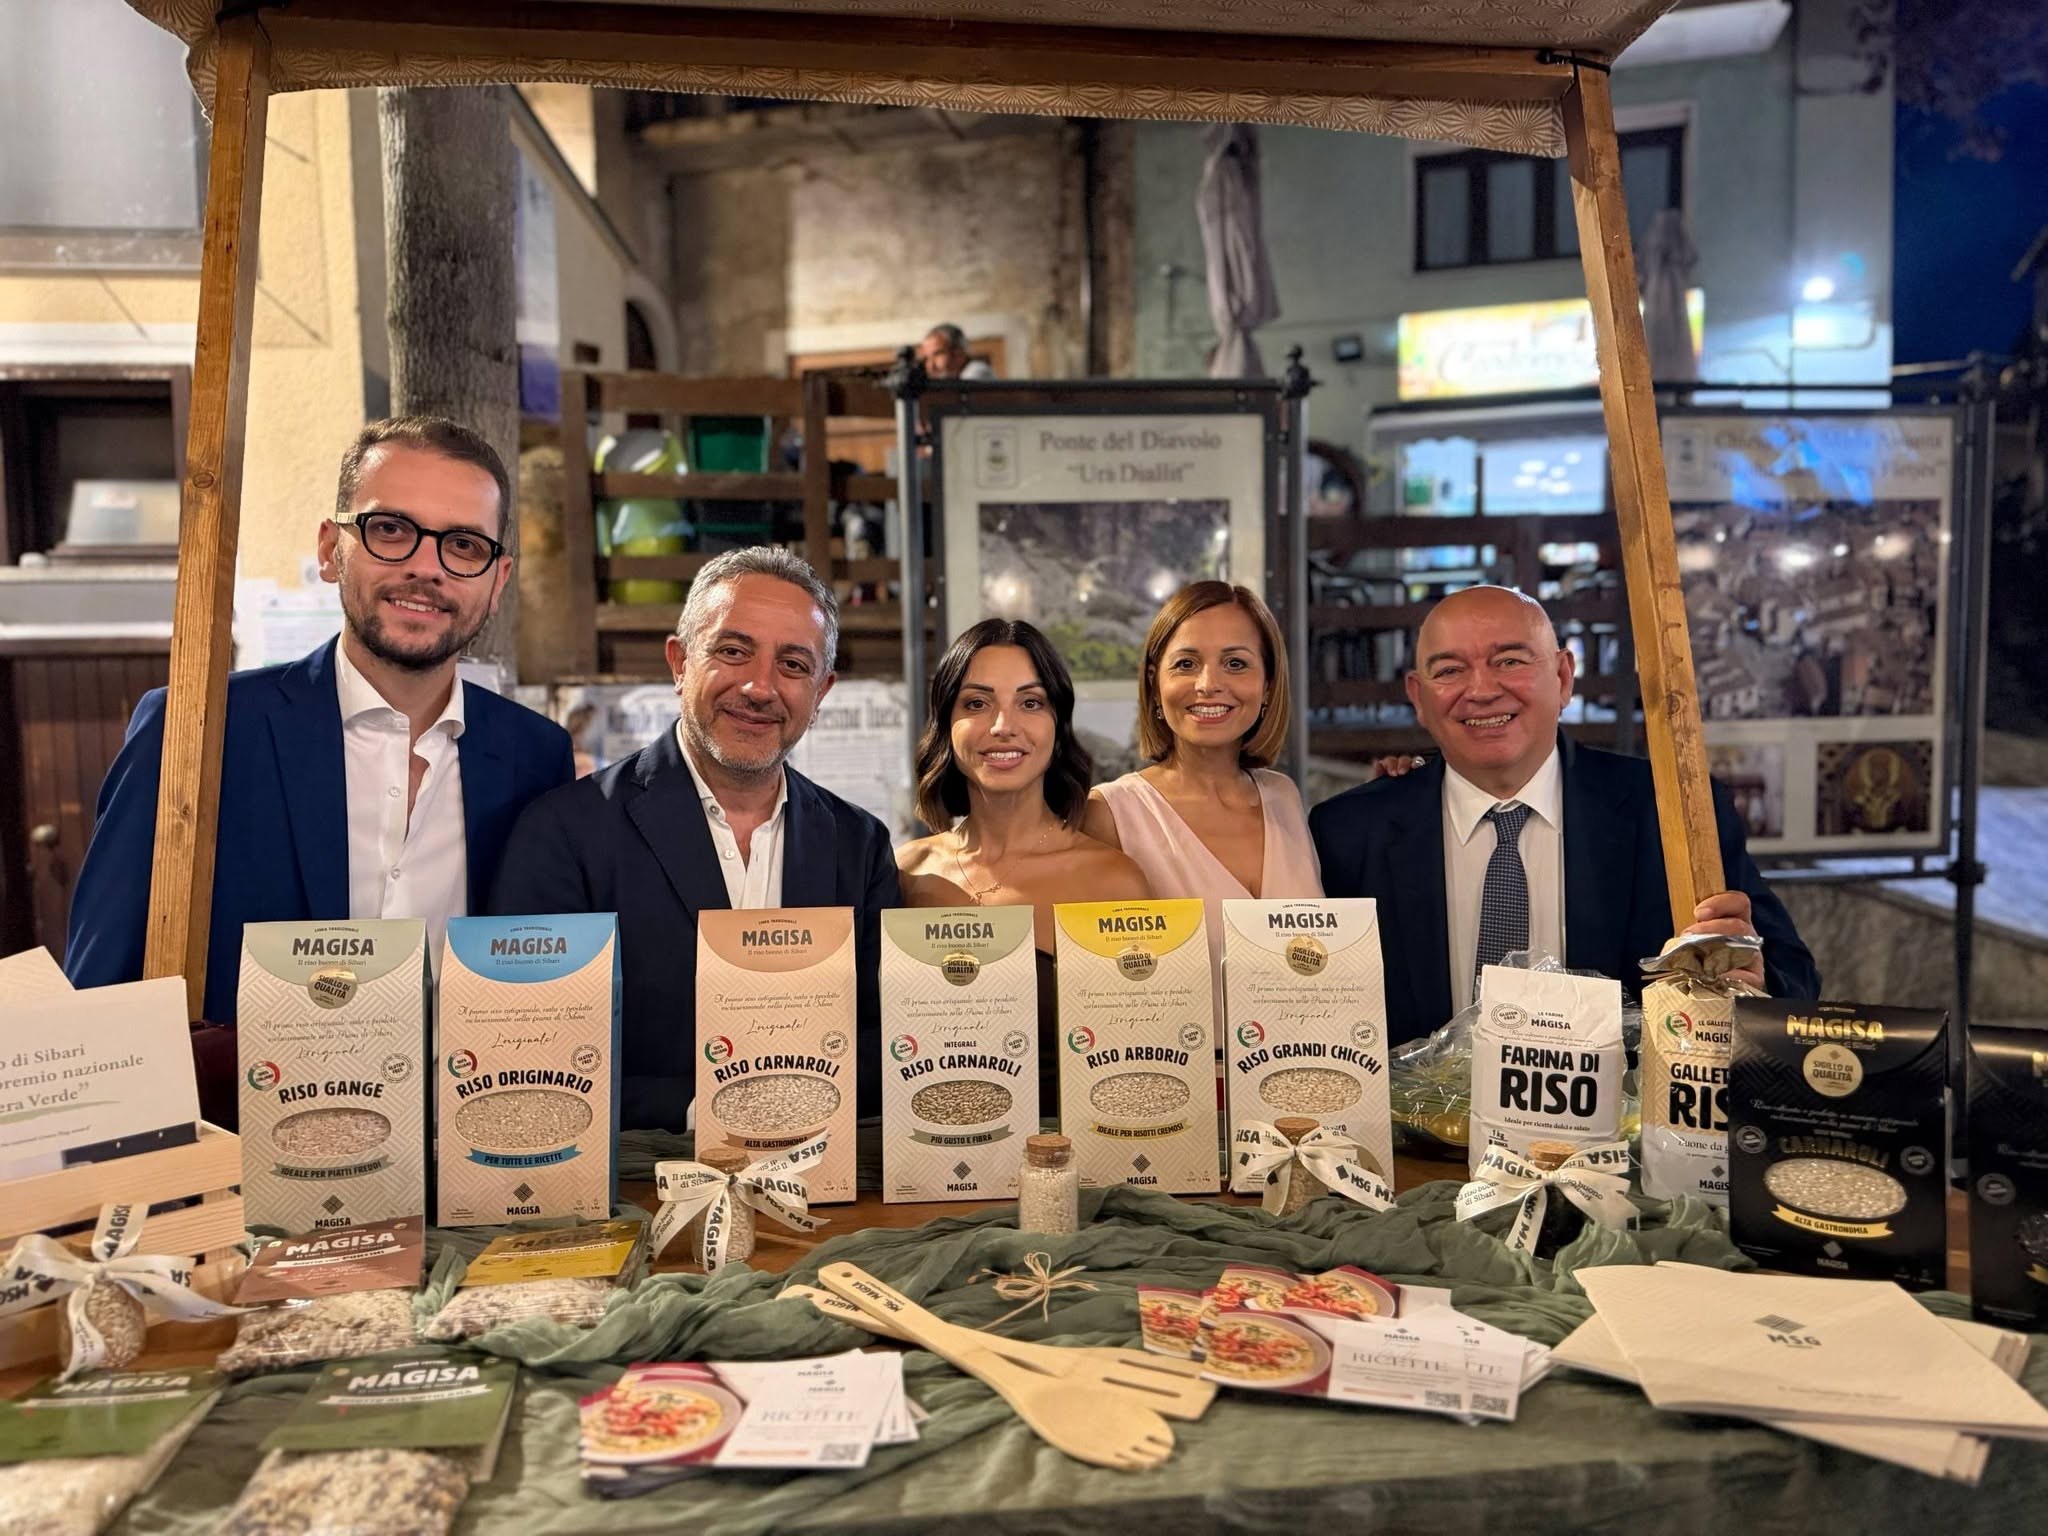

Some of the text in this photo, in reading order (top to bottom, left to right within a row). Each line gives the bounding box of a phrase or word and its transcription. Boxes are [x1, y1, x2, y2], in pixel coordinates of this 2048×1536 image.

[1039, 428, 1221, 451] Ponte del Diavolo
[1098, 915, 1167, 934] MAGISA
[1268, 912, 1338, 929] MAGISA
[742, 929, 813, 947] MAGISA
[925, 922, 994, 940] MAGISA
[292, 938, 375, 956] MAGISA
[490, 937, 567, 956] MAGISA
[1293, 946, 1315, 958] SIGILLO
[1122, 953, 1144, 961] SIGILLO
[318, 974, 351, 991] SIGILLO DI
[1356, 1029, 1371, 1037] GLUTEN
[1531, 1018, 1571, 1030] MAGISA
[1786, 1014, 1884, 1041] MAGISA
[944, 1040, 977, 1048] INTEGRALE
[12, 1044, 85, 1067] di Sibari
[1086, 1046, 1189, 1070] RISO ARBORIO
[1236, 1042, 1383, 1075] RISO GRANDI CHICCHI
[1501, 1044, 1599, 1073] FARINA DI
[62, 1054, 144, 1079] nazionale
[387, 1062, 405, 1071] GLUTEN
[713, 1055, 841, 1084] RISO CARNAROLI
[900, 1054, 1022, 1081] RISO CARNAROLI
[1813, 1060, 1854, 1073] SIGILLO DI
[279, 1081, 384, 1105] RISO GANGE
[456, 1069, 593, 1100] RISO ORIGINARIO
[1499, 1067, 1597, 1117] RISO
[1097, 1122, 1184, 1137] IDEALE PER RISOTTI CREMOSI
[1496, 1130, 1505, 1140] kg
[744, 1136, 809, 1148] ALTA GASTRONOMIA
[943, 1135, 964, 1145] GUSTO
[965, 1135, 970, 1144] E
[971, 1133, 993, 1144] FIBRA
[1710, 1142, 1722, 1151] da
[484, 1151, 563, 1166] PER TUTTE LE RICETTE
[1780, 1136, 1889, 1168] CARNAROLI
[281, 1161, 382, 1179] IDEALE PER PIATTI FREDDI
[672, 1172, 697, 1181] Il riso
[946, 1183, 978, 1192] MAGISA
[1126, 1176, 1158, 1185] MAGISA
[1350, 1172, 1371, 1193] MSG
[1699, 1180, 1730, 1190] MAGIS
[1463, 1187, 1478, 1199] riso
[1465, 1189, 1497, 1206] di Sibari
[1577, 1180, 1604, 1201] buono
[507, 1205, 541, 1216] MAGISA
[1524, 1194, 1538, 1220] MSG
[315, 1217, 351, 1228] MAGISA
[1794, 1215, 1869, 1235] ALTA GASTRONOMIA
[285, 1232, 395, 1256] MAGISA
[852, 1281, 882, 1300] MAGISA
[823, 1298, 860, 1313] MAGISA
[1384, 1333, 1421, 1342] MAGISA
[1767, 1333, 1823, 1348] MSG
[1352, 1352, 1449, 1373] RICETTE
[53, 1376, 192, 1395] MAGISA
[347, 1366, 479, 1391] MAGISA
